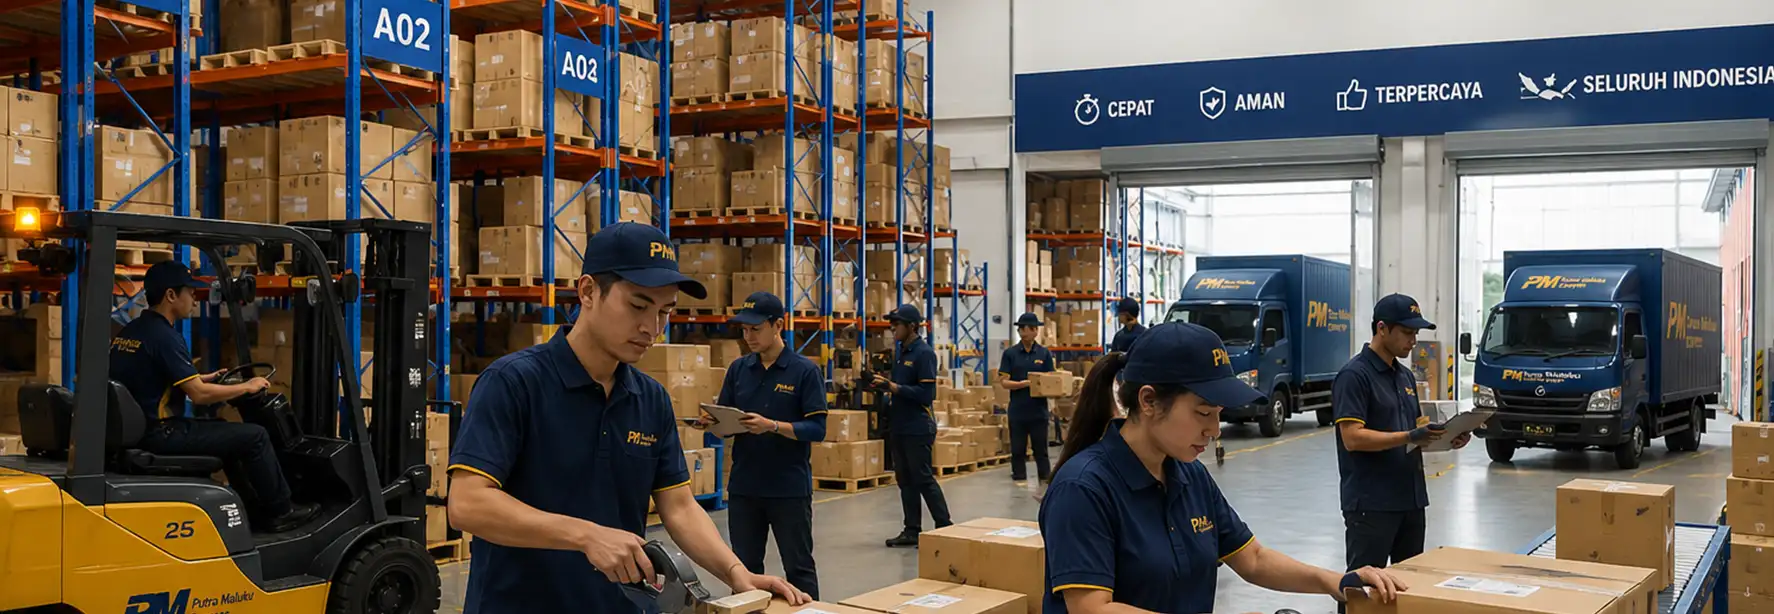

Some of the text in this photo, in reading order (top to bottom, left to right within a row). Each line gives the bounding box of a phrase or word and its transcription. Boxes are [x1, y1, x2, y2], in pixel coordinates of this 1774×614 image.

[373, 7, 430, 51] A02
[1583, 66, 1774, 94] SELURUH INDONESIA
[1234, 92, 1285, 112] AMAN
[1375, 81, 1483, 103] TERPERCAYA
[1108, 100, 1154, 118] CEPAT
[1521, 275, 1561, 289] PM
[1307, 300, 1328, 327] PM
[1666, 301, 1687, 339] PM
[1502, 369, 1523, 382] PM
[165, 520, 196, 539] 25
[124, 588, 192, 614] PM
[192, 597, 219, 609] Putra
